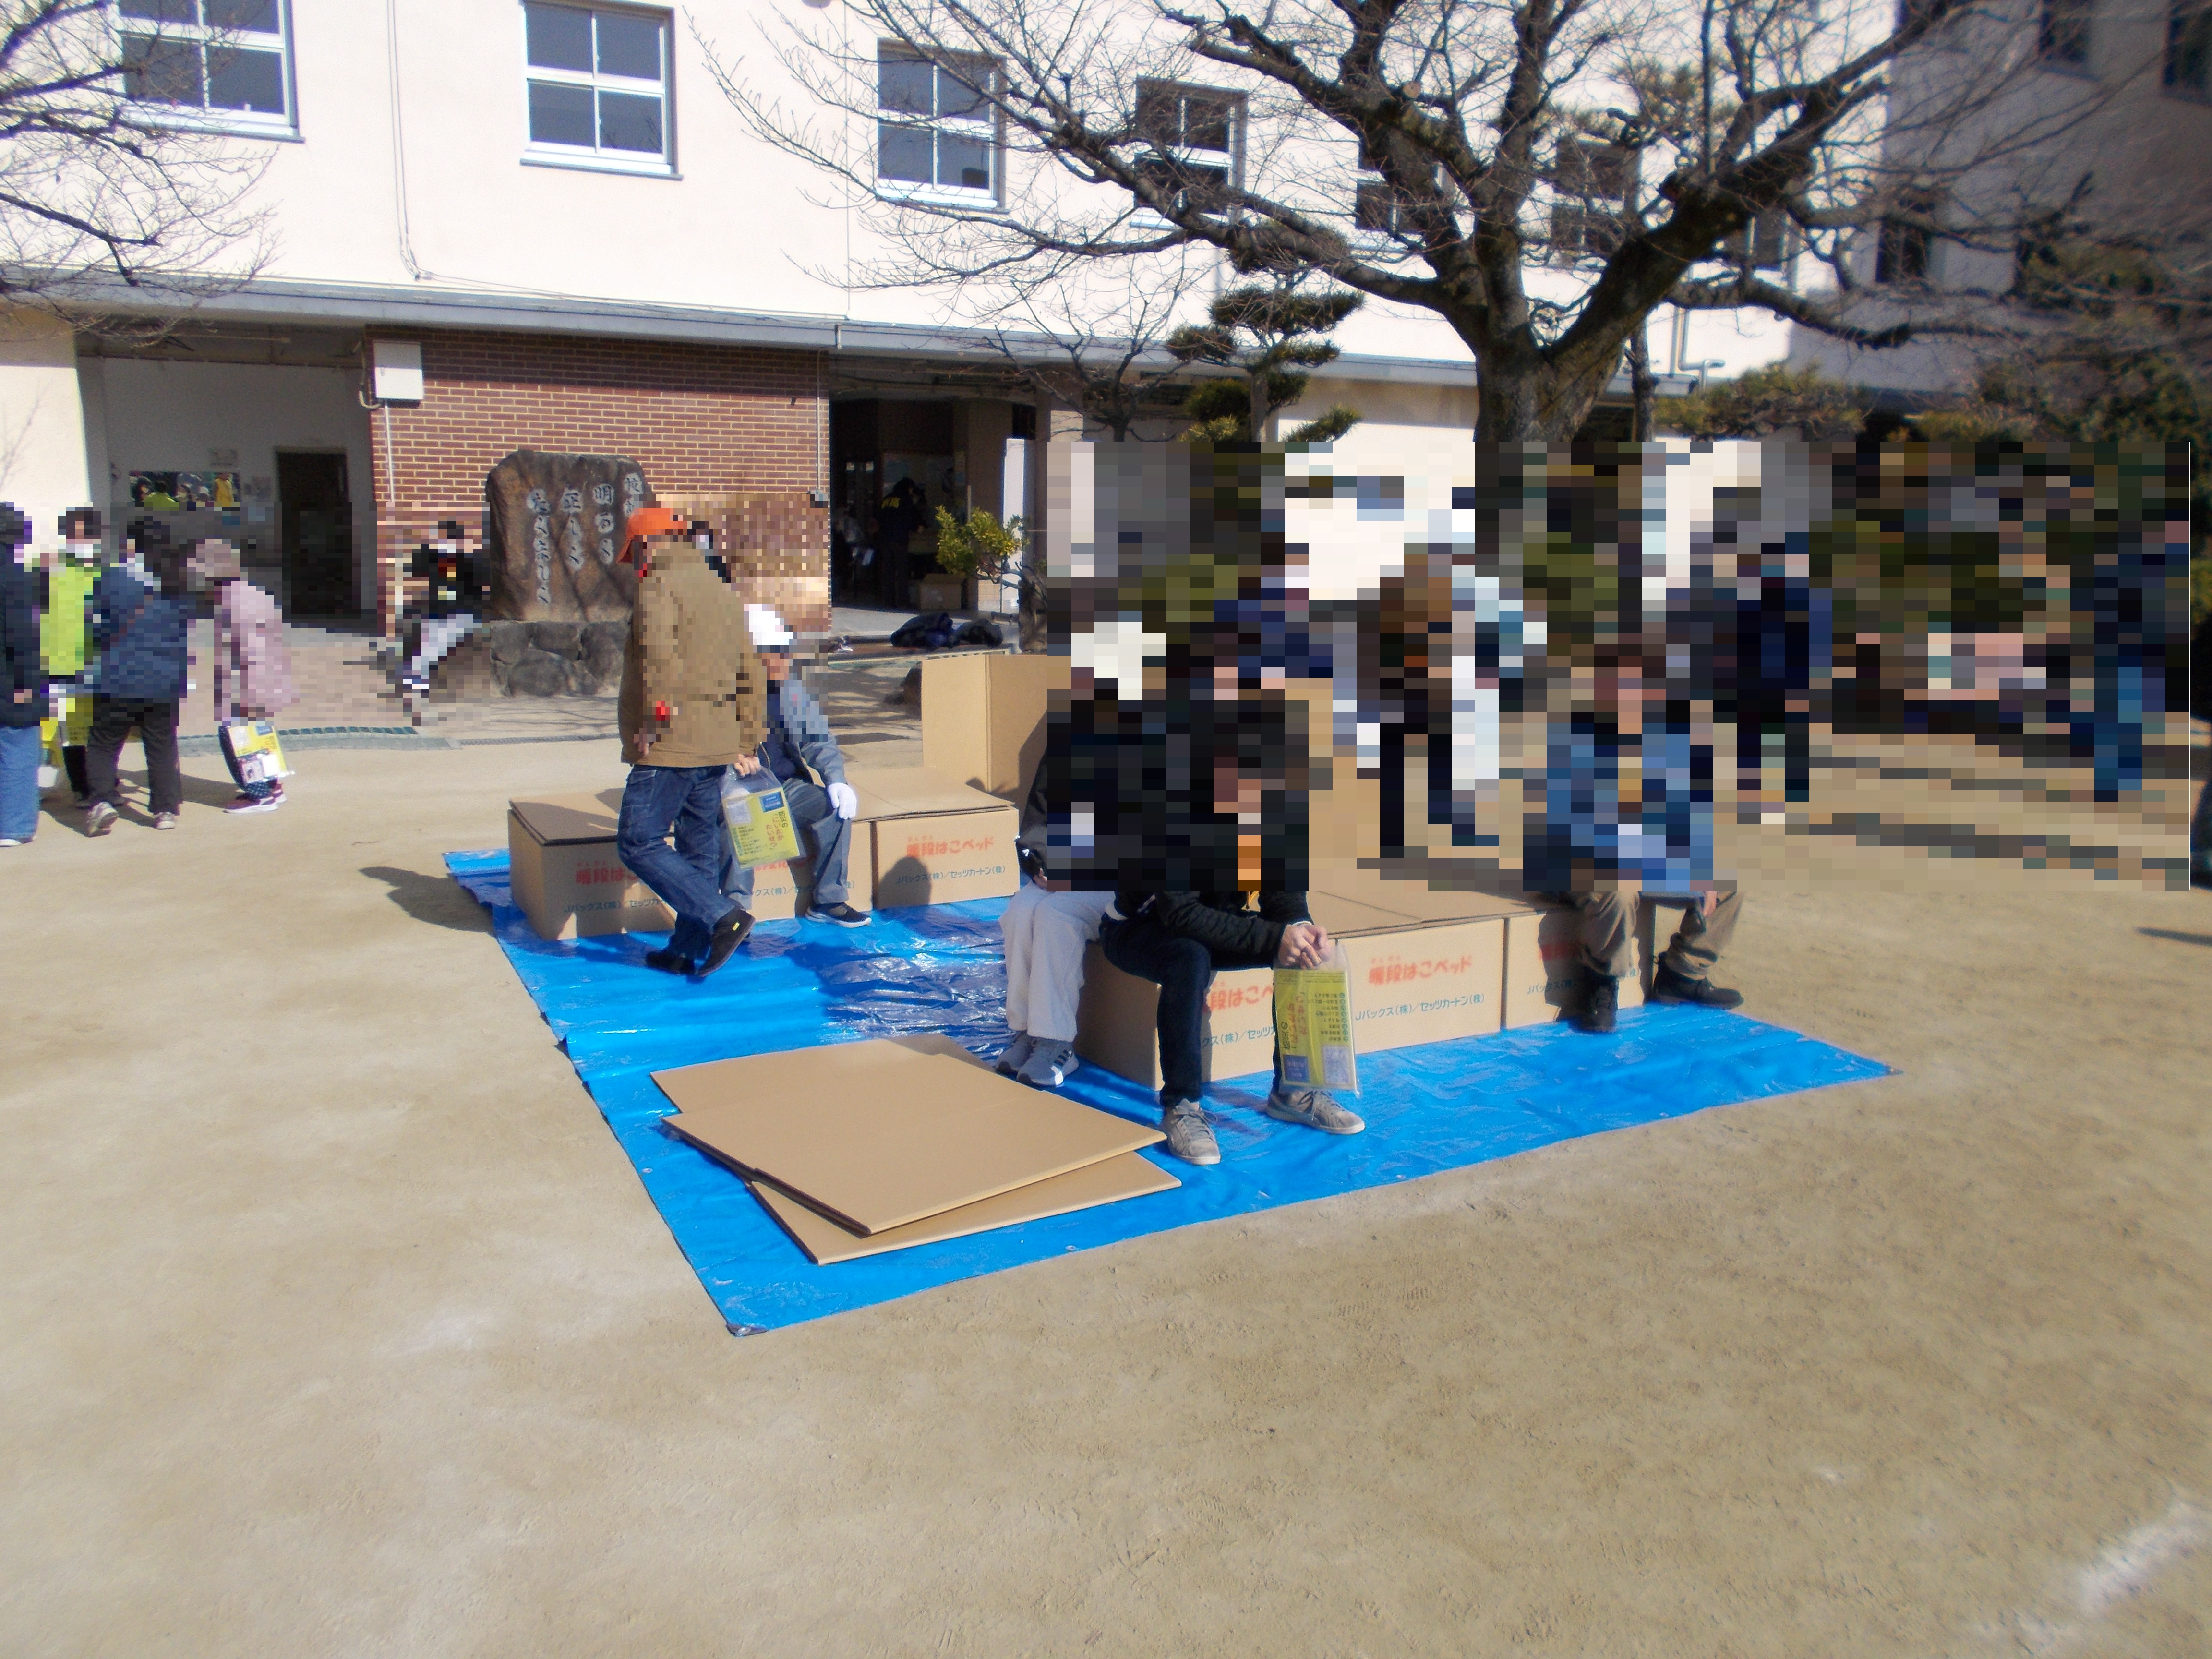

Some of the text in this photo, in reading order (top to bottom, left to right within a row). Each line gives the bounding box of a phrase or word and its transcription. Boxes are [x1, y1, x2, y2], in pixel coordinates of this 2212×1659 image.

[594, 485, 613, 557] 明るい
[778, 810, 788, 828] 防災の
